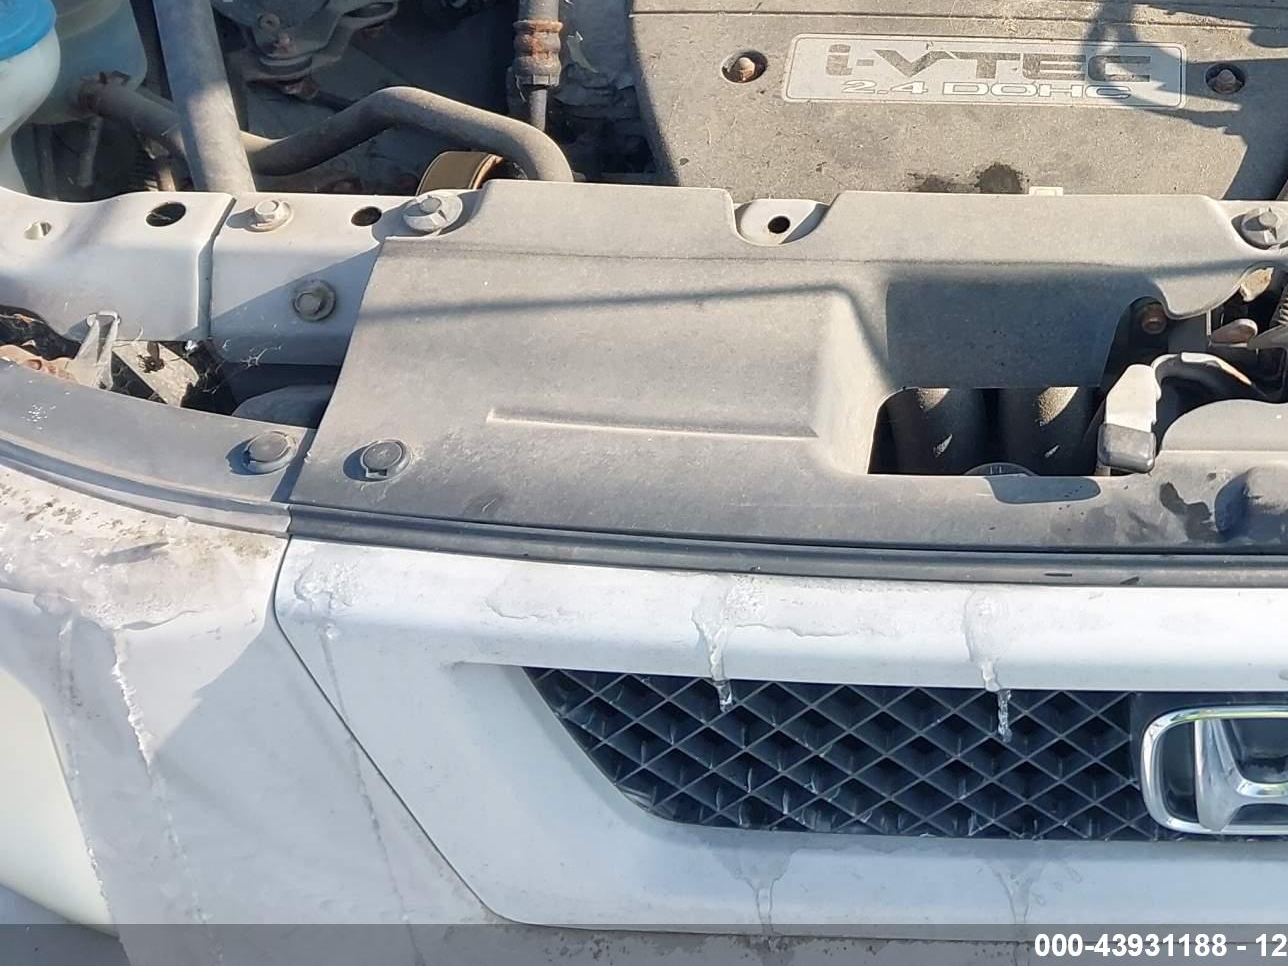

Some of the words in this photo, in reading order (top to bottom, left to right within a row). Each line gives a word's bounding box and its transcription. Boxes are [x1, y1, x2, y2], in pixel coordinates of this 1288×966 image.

[825, 42, 1152, 83] i-VTEC
[841, 79, 929, 96] 2.4
[941, 80, 1131, 100] DOHC
